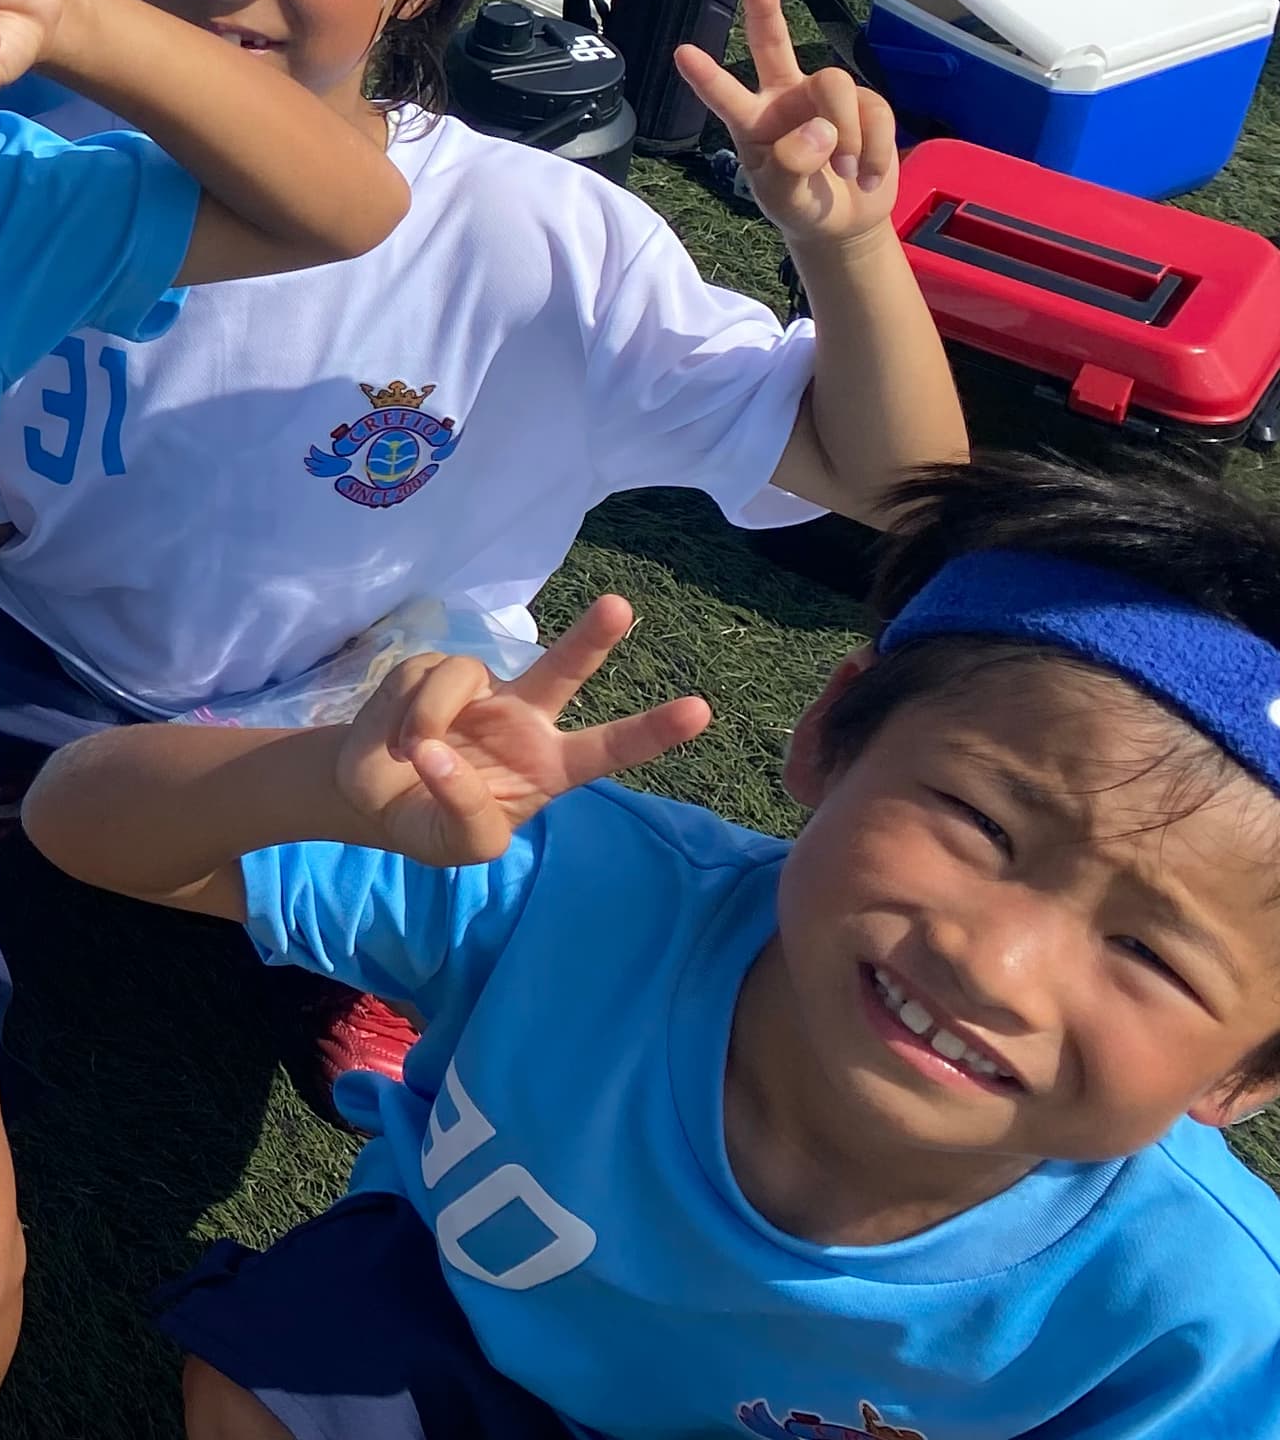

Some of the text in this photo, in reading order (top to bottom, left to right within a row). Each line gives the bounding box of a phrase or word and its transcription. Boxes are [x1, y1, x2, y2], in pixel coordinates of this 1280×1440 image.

[570, 35, 616, 61] 56
[24, 335, 127, 485] 31
[349, 412, 440, 443] CREFIO
[346, 471, 431, 504] SINCE 2003
